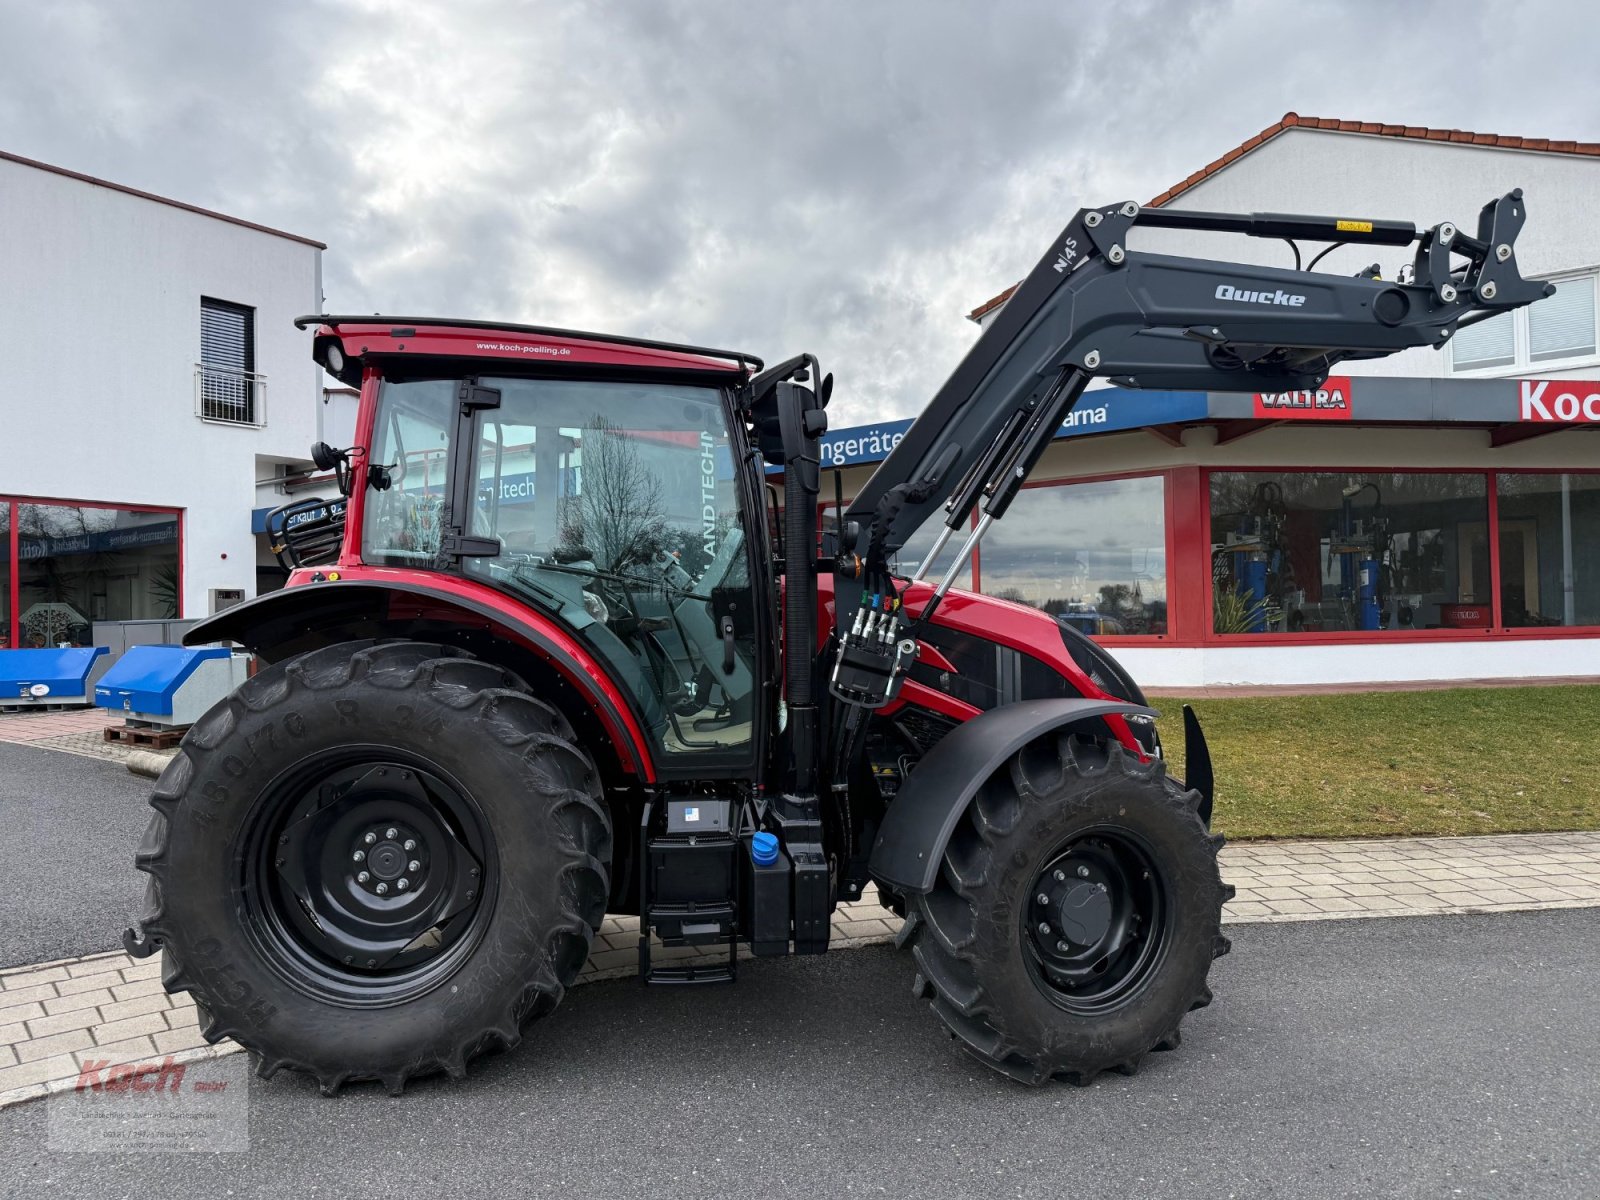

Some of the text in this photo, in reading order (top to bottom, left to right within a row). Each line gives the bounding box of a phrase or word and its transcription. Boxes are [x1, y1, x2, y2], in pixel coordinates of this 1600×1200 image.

[1215, 285, 1306, 307] Quicke
[476, 343, 571, 356] www.koch-poelling.de
[1260, 389, 1347, 409] VALTRA
